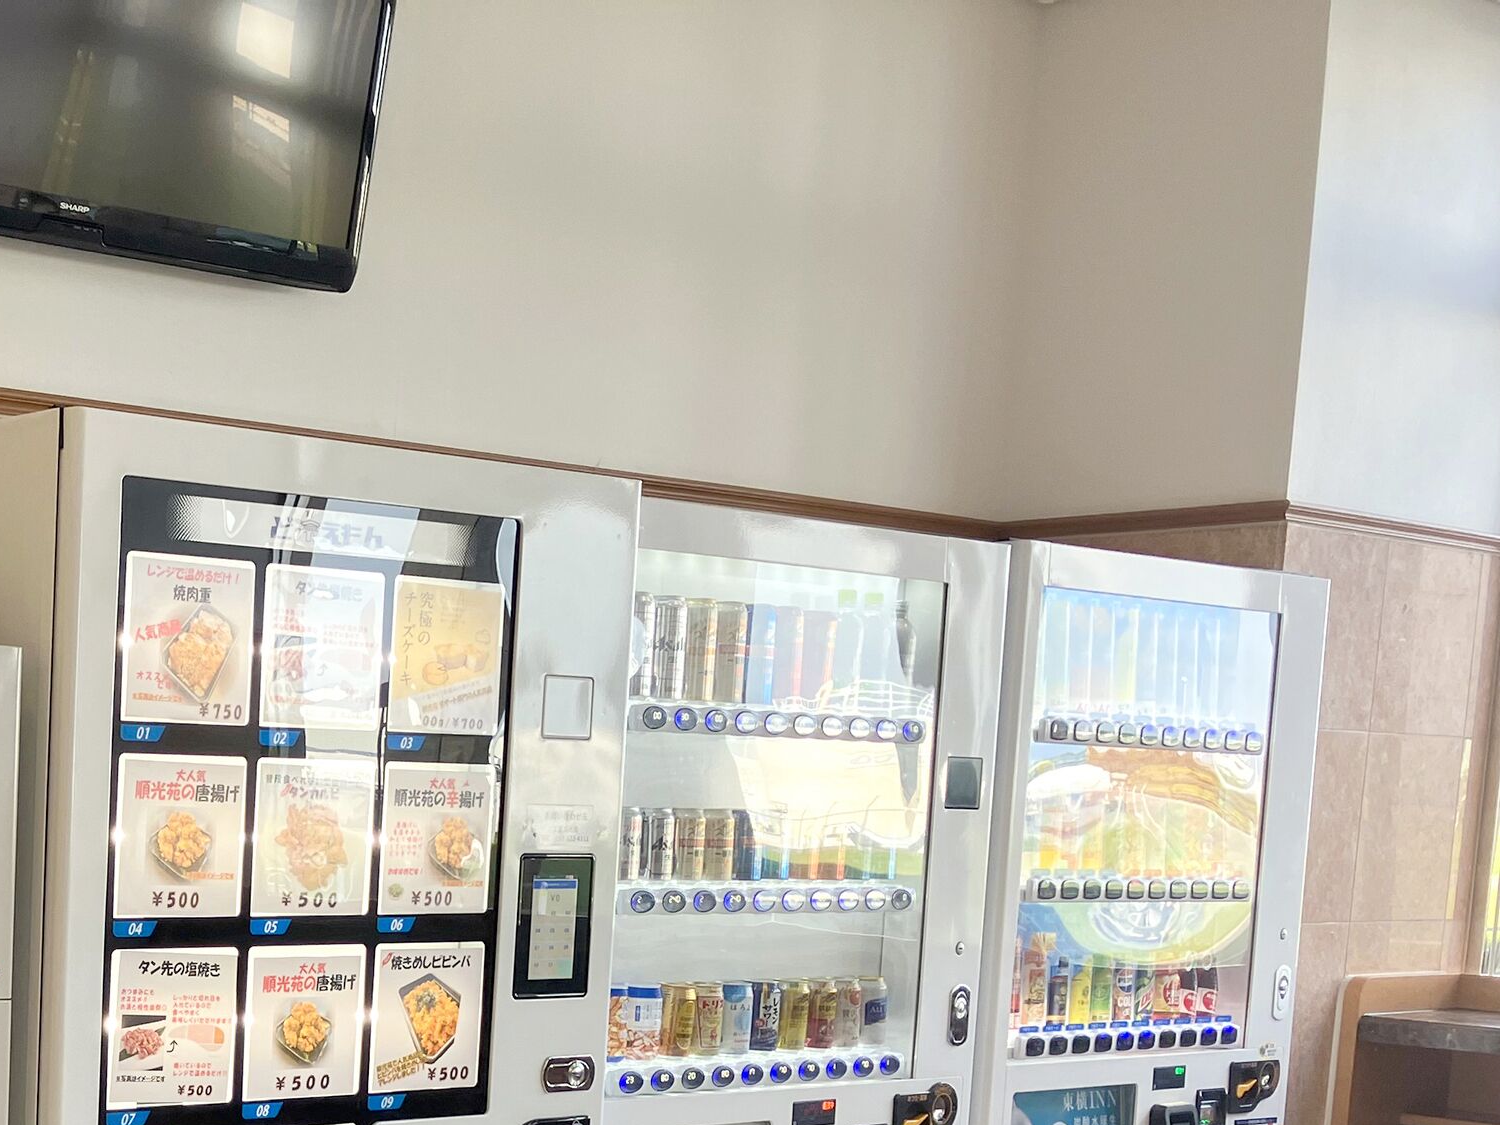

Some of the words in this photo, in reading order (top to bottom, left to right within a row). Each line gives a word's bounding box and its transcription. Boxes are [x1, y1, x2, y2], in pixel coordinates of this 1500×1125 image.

[59, 201, 91, 213] SHARP
[173, 584, 212, 604] 焼肉重
[417, 591, 434, 646] 究極の
[134, 618, 182, 642] 人気商品
[399, 591, 418, 687] チーズケーキ
[199, 703, 243, 721] ¥750
[135, 726, 151, 740] 01
[272, 731, 289, 745] 02
[399, 736, 414, 749] 03
[175, 768, 207, 783] 大人気
[429, 777, 456, 790] 大人気
[134, 779, 241, 804] 順光苑の唐揚げ
[393, 787, 485, 809] 順光苑の辛揚げ
[152, 891, 200, 909] ¥500
[281, 891, 338, 908] ¥500
[411, 890, 453, 907] ¥500
[127, 922, 143, 936] 04
[263, 920, 278, 933] 05
[390, 918, 404, 931] 06
[138, 959, 222, 978] タン先の塩焼き
[299, 962, 327, 974] 大人気
[390, 955, 472, 971] 焼きめしビビンバ
[262, 974, 357, 993] 順光苑の唐揚げ
[772, 997, 780, 1026] レモン
[427, 1066, 469, 1081] ¥500
[177, 1084, 213, 1096] ¥500
[275, 1074, 331, 1091] ¥500
[380, 1096, 395, 1109] 09
[1062, 1090, 1118, 1112] 東横INN
[256, 1104, 270, 1117] 08
[120, 1113, 136, 1125] 07
